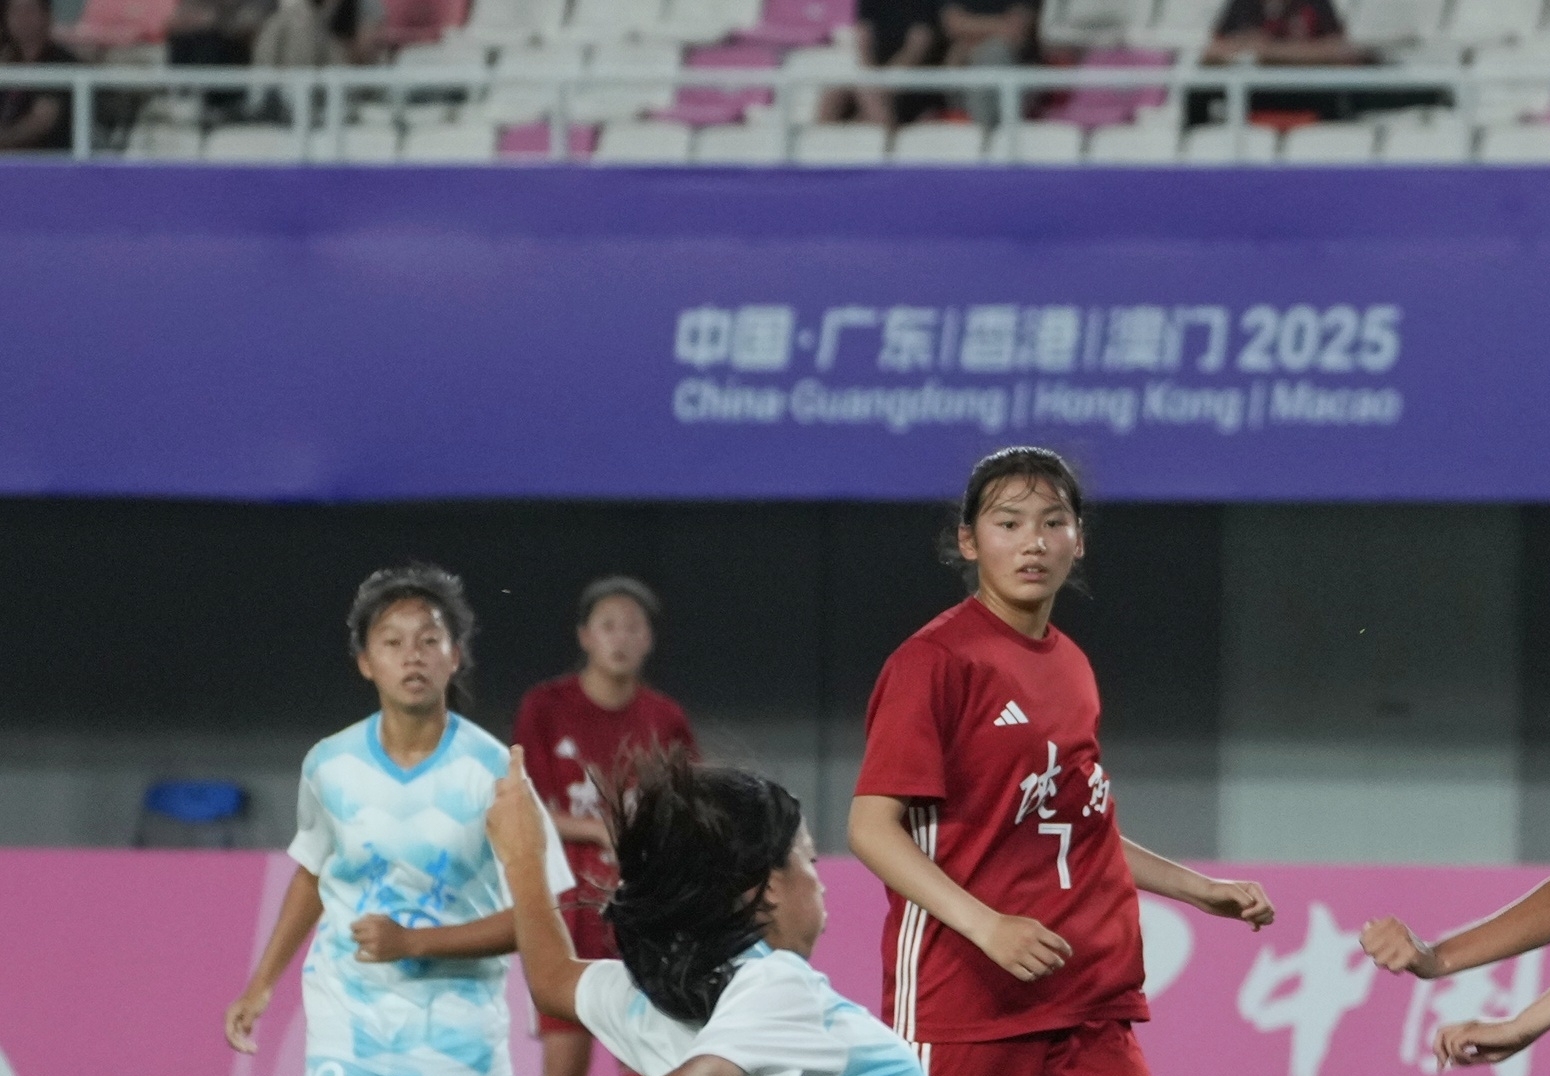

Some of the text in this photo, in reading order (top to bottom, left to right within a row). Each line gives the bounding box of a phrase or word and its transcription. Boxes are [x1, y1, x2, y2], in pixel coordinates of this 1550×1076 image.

[1238, 304, 1400, 374] 2025
[673, 378, 786, 424] China
[1271, 380, 1400, 427] Macao
[1038, 823, 1072, 889] 7
